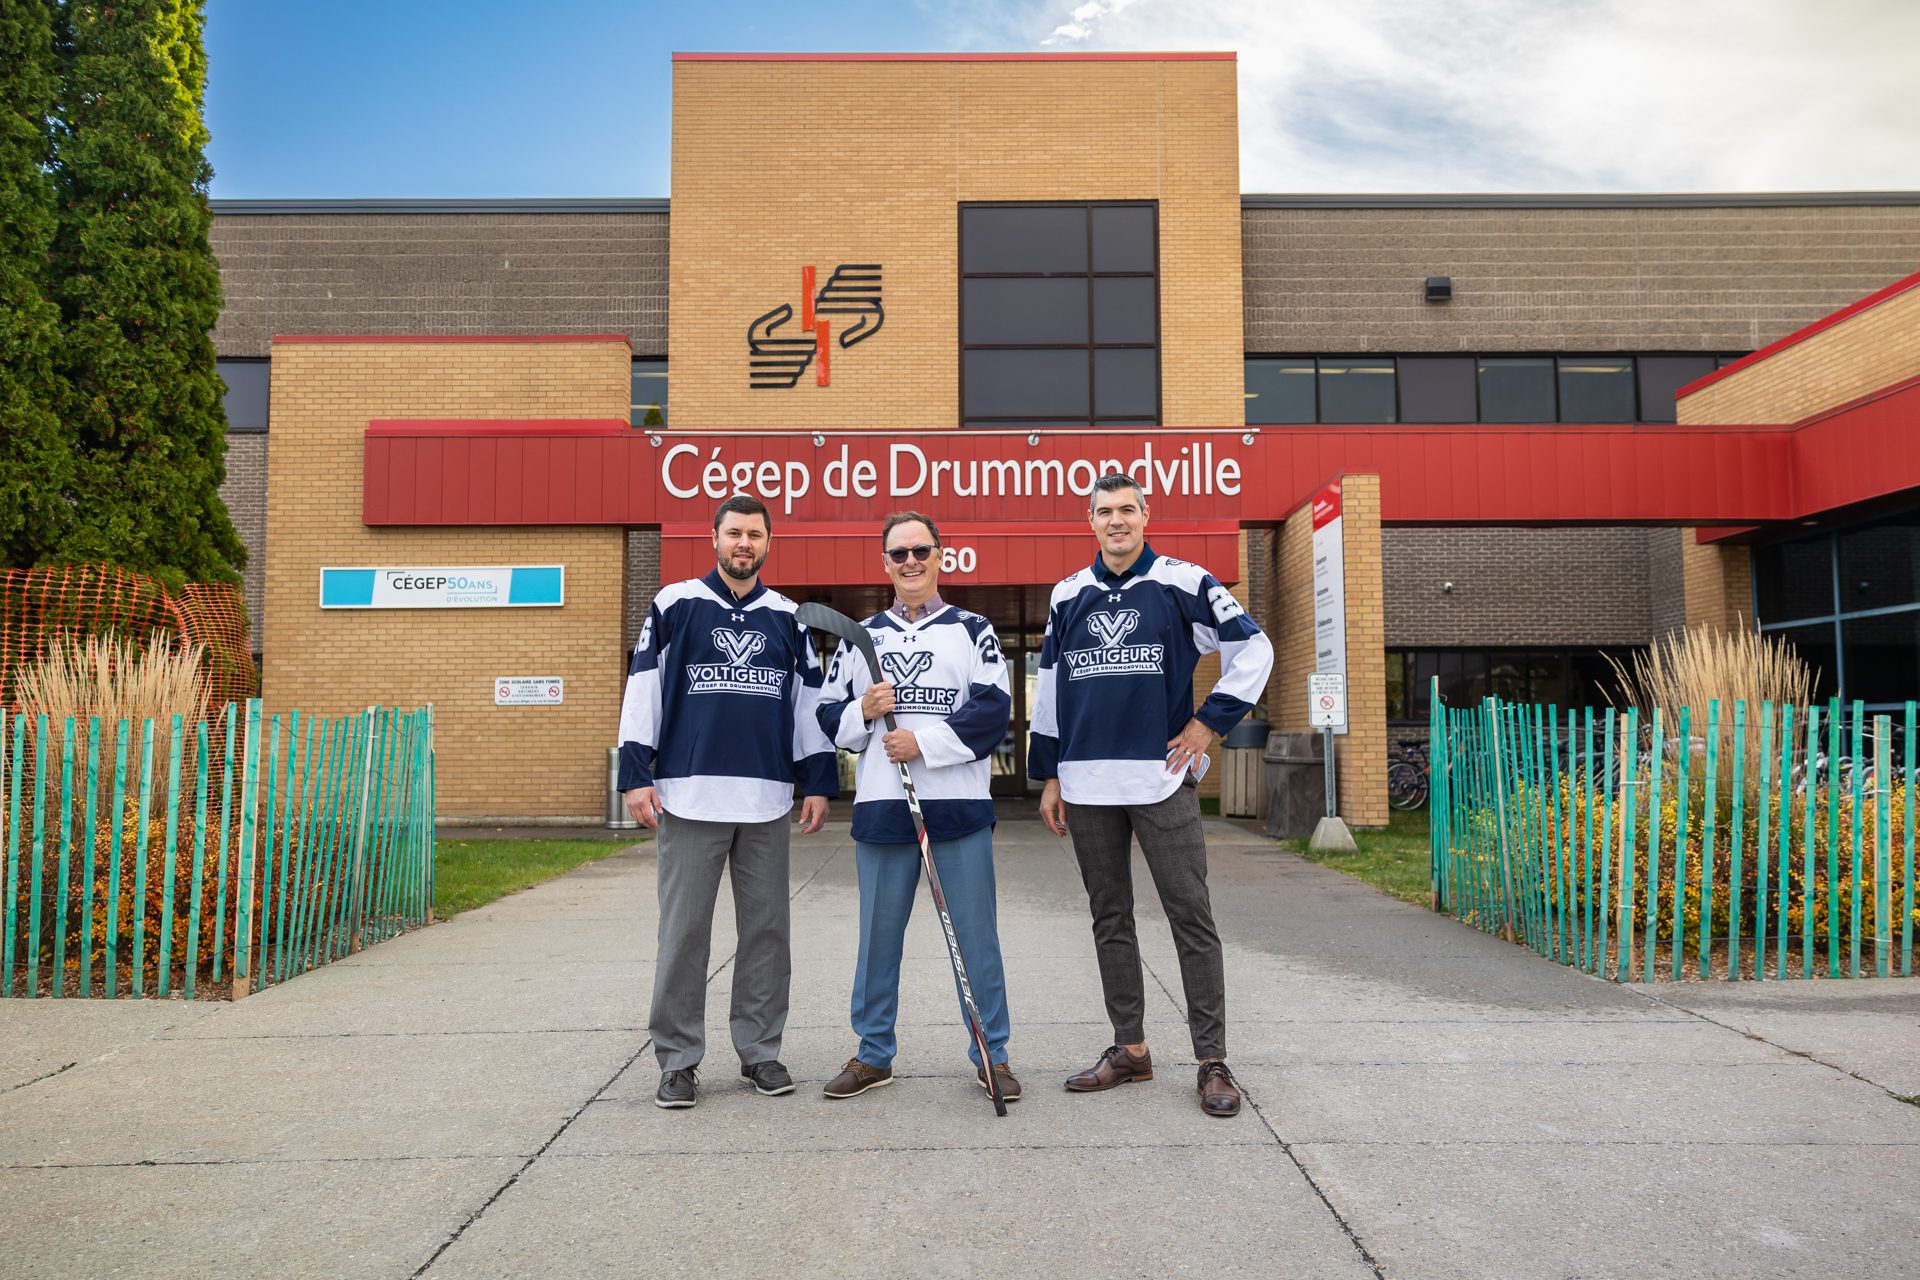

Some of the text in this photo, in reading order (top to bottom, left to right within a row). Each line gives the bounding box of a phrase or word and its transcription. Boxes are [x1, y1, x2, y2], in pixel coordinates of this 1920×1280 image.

[661, 443, 811, 515] Cégep
[823, 444, 877, 498] de
[392, 574, 447, 590] CÉGEP
[1068, 647, 1161, 667] VOLTIGEURS
[689, 666, 784, 687] VOLTIGEURS
[729, 683, 778, 693] DRUMMONDVILLE
[896, 688, 957, 705] IGEURS
[941, 911, 977, 1012] JETSPEED
